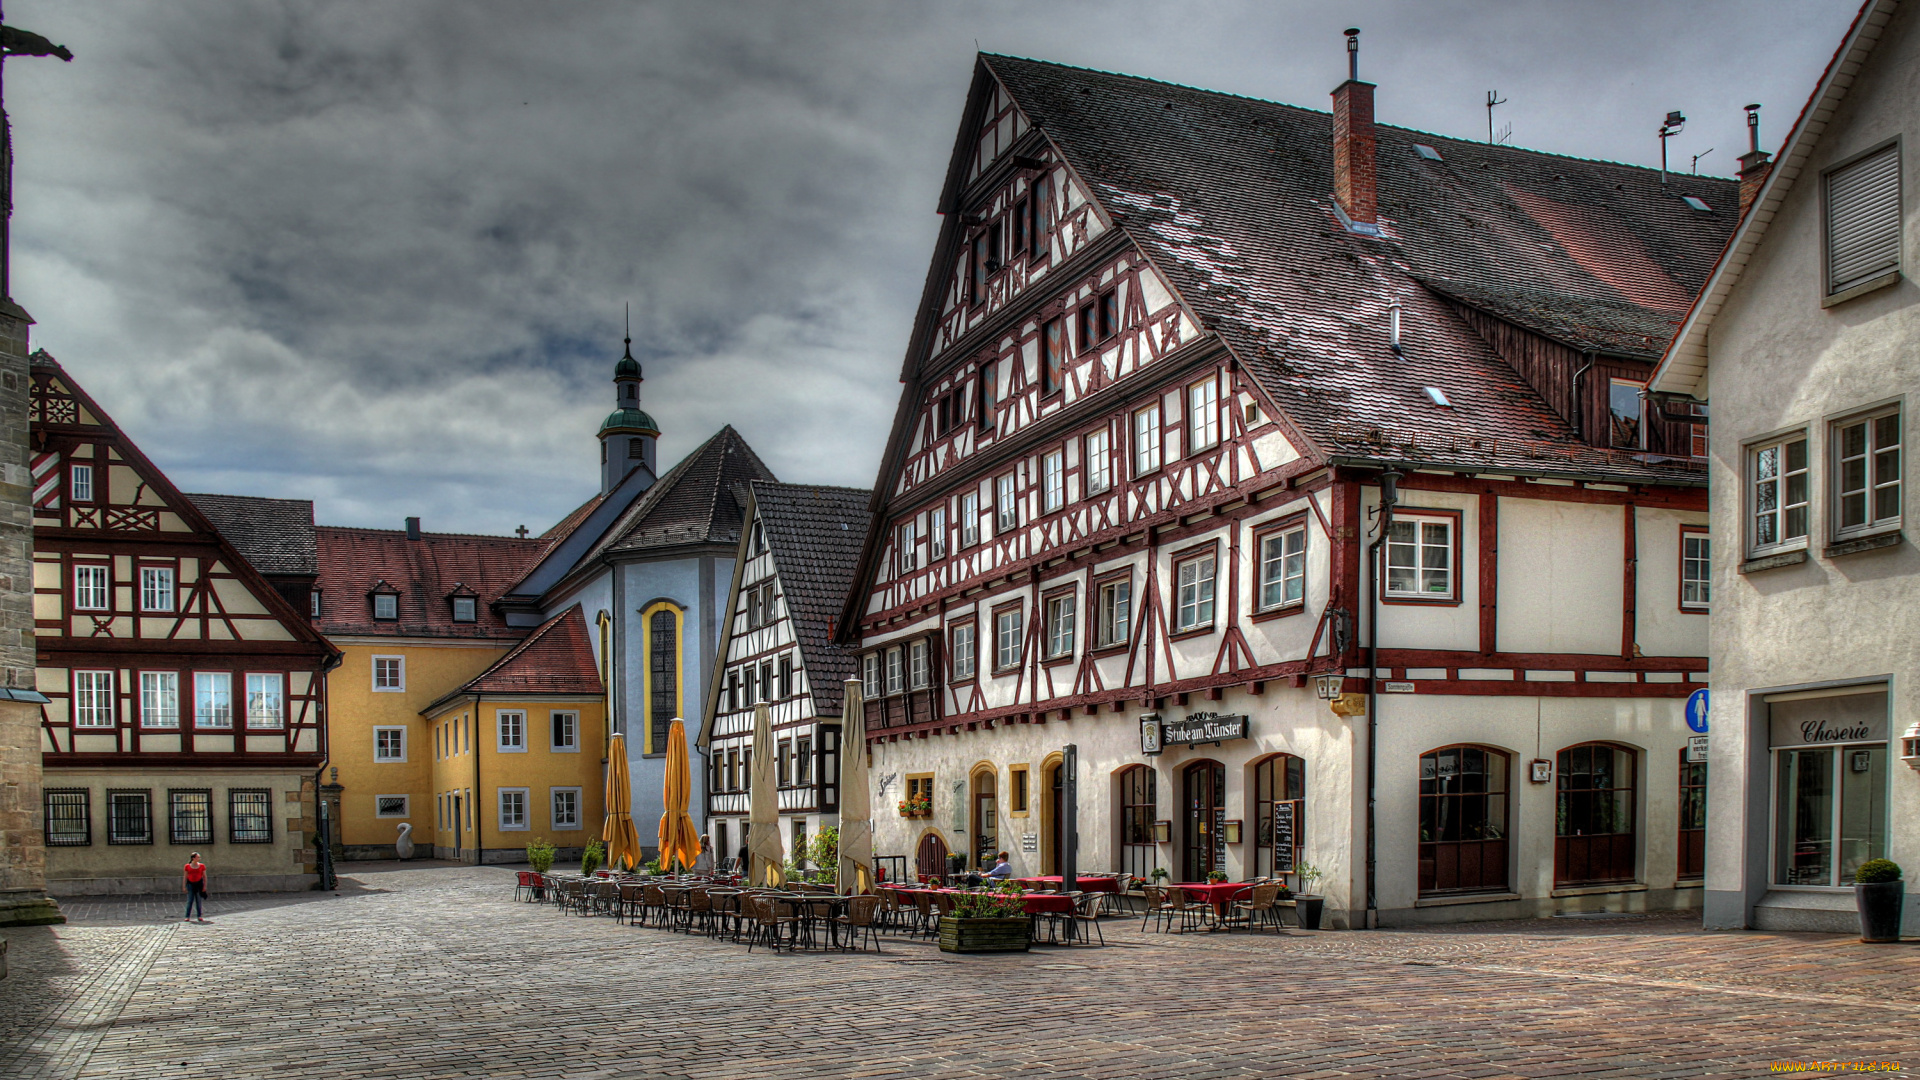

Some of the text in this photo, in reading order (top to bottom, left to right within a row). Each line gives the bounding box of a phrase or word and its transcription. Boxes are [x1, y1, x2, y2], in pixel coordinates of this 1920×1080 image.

[1165, 722, 1241, 743] Stube am Münster
[1800, 720, 1870, 742] Choserie
